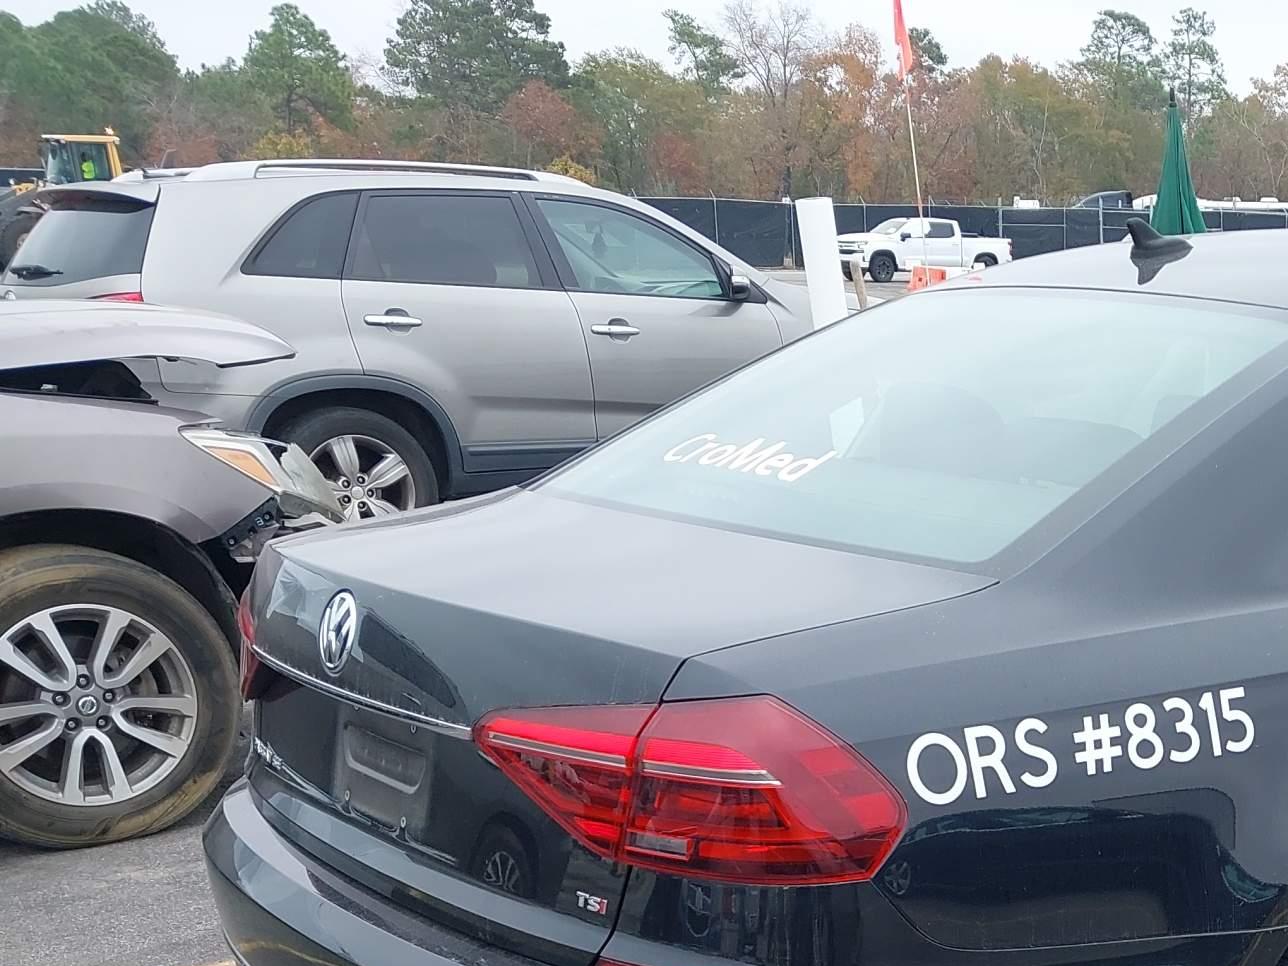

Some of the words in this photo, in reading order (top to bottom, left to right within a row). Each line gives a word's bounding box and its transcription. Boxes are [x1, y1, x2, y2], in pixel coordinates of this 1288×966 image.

[664, 433, 838, 482] CroMed
[906, 717, 1059, 805] ORS
[1072, 686, 1256, 776] #8315
